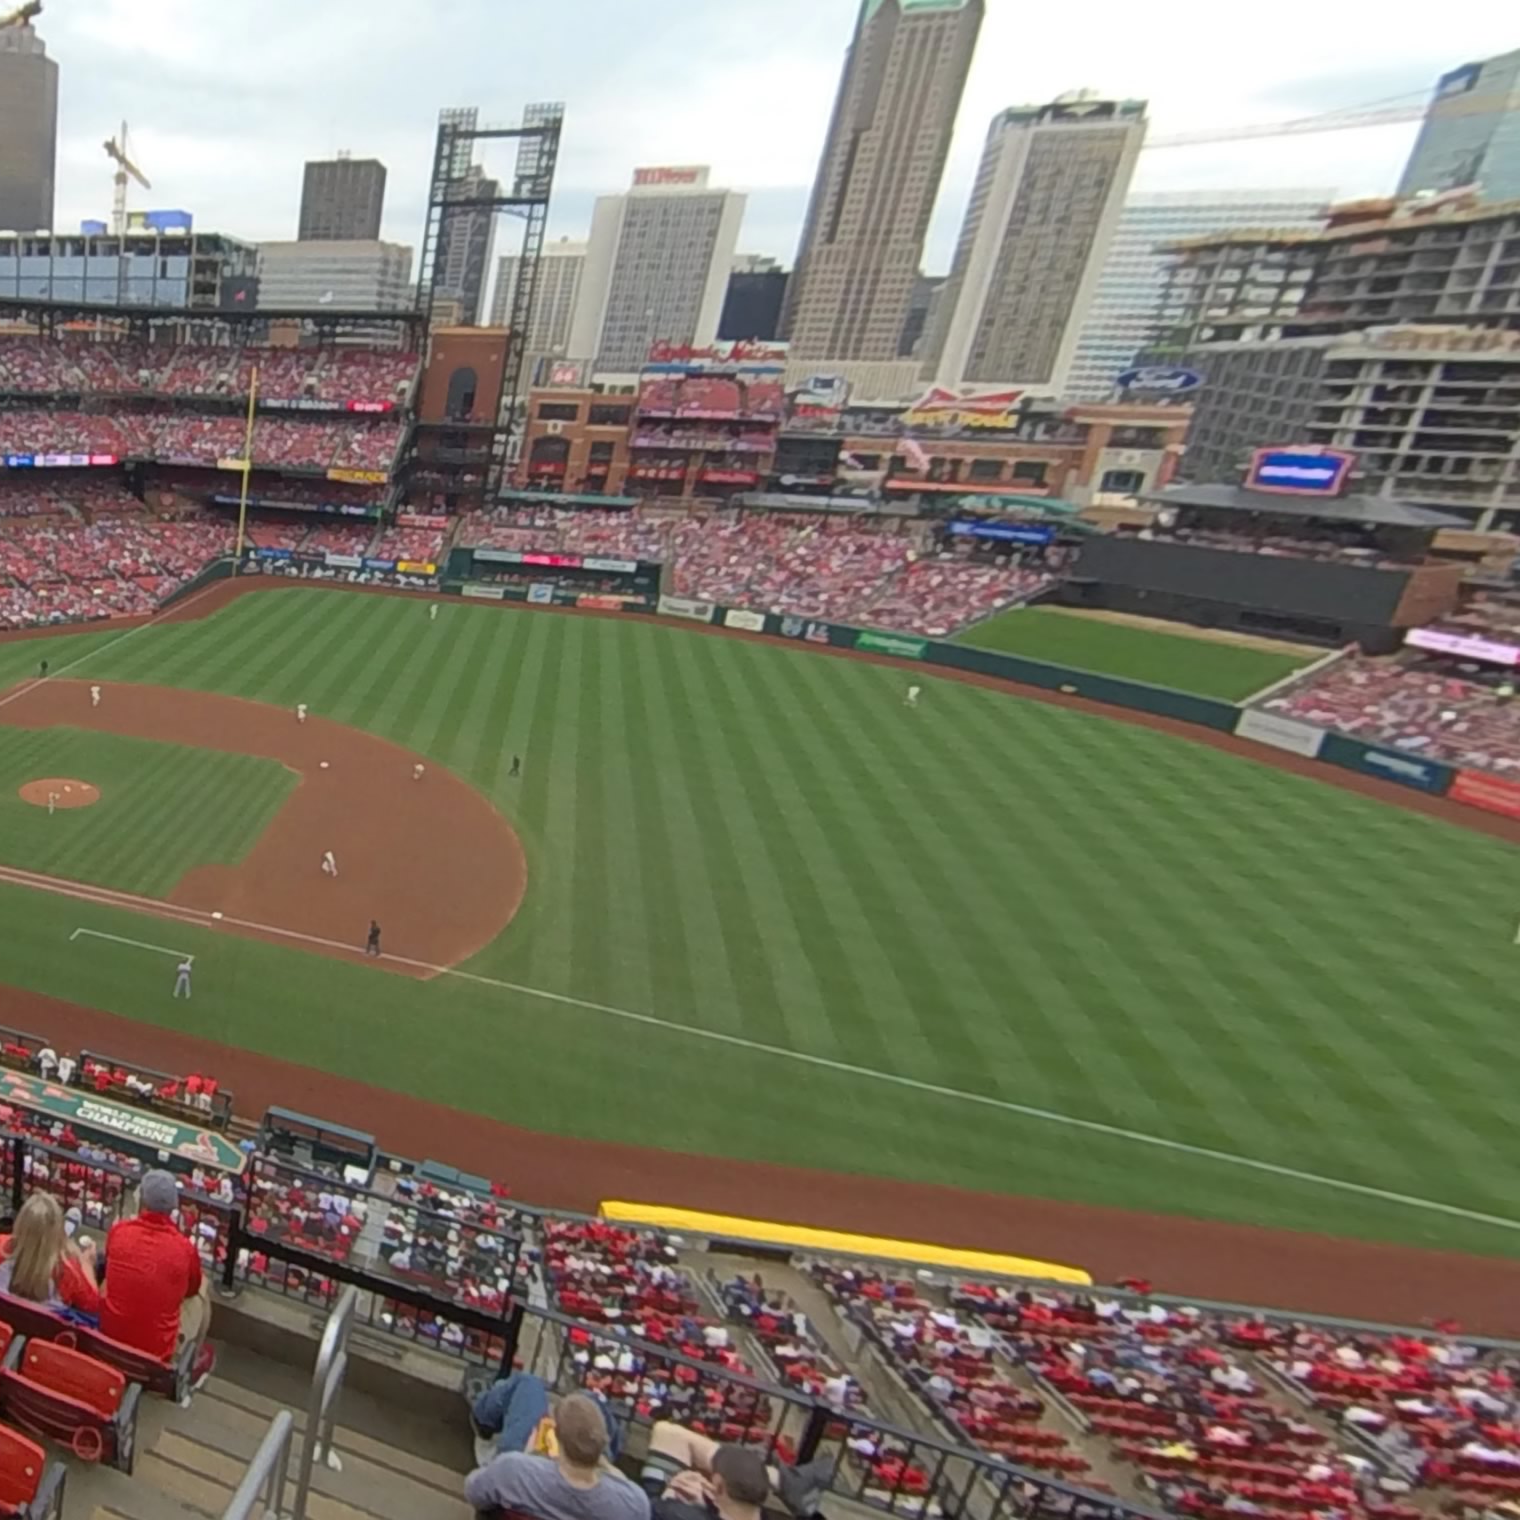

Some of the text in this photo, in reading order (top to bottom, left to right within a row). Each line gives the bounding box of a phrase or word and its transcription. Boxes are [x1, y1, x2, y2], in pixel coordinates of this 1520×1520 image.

[76, 1107, 174, 1144] CHAMPIONS
[83, 1100, 178, 1135] WORLD SERIES
